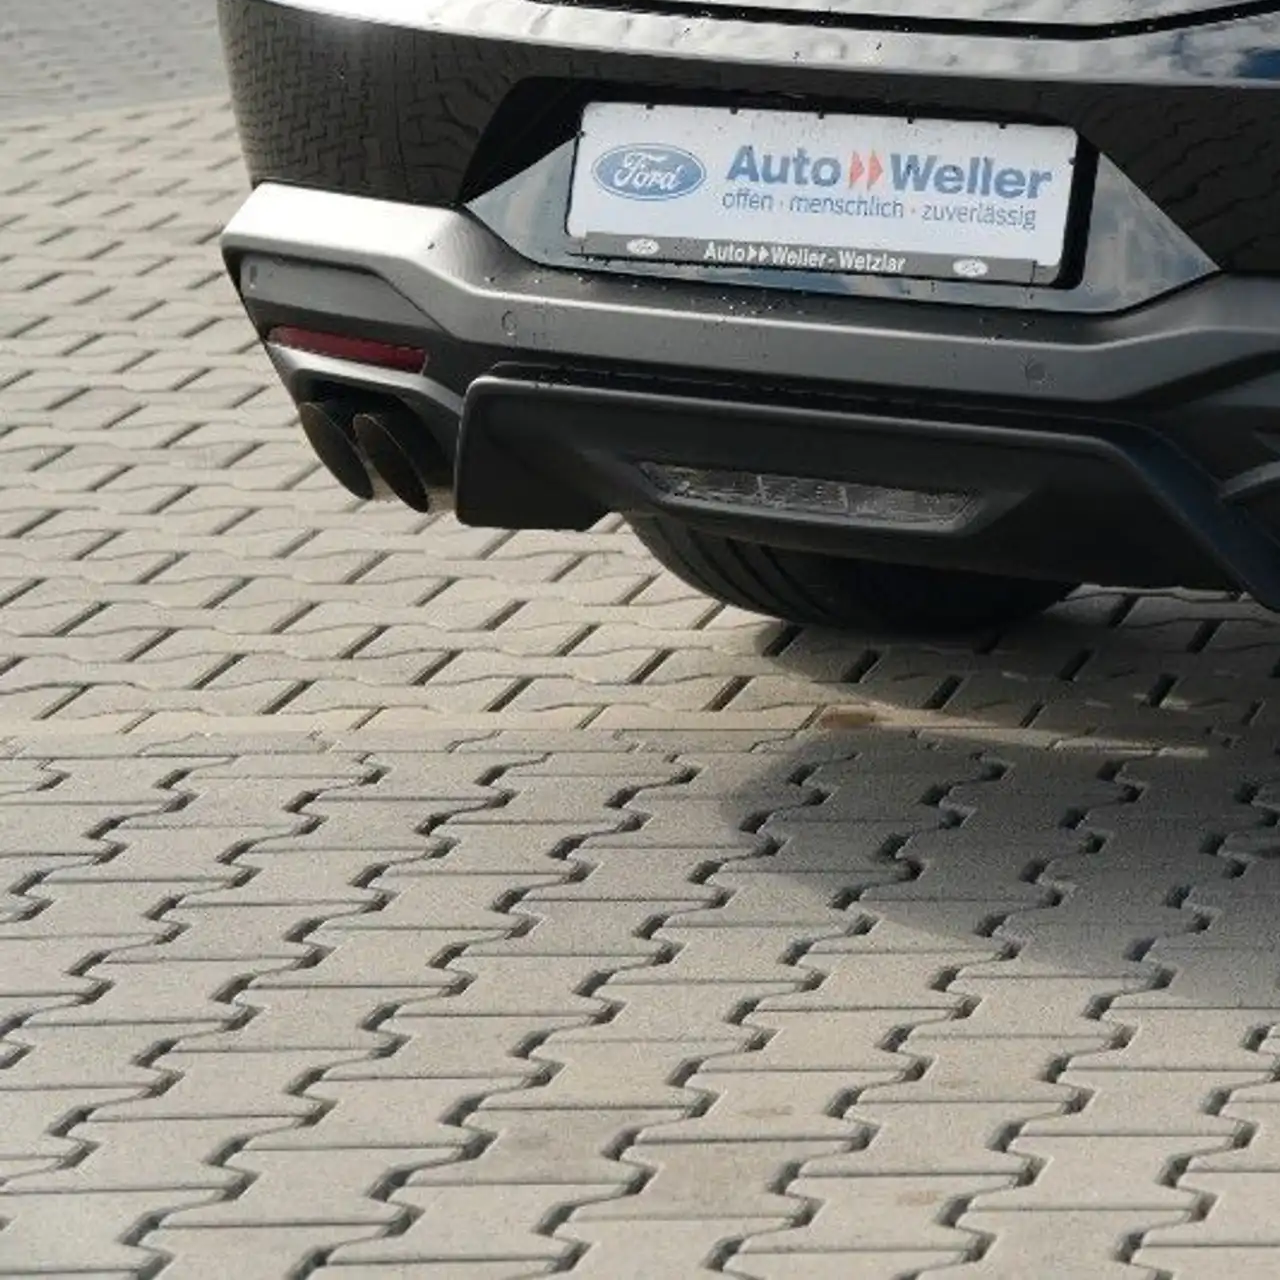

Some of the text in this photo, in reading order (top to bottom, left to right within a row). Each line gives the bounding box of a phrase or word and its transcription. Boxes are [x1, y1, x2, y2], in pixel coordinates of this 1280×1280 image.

[612, 149, 683, 192] Ford
[726, 144, 1053, 201] Auto Weller
[721, 189, 1037, 231] offen menschlich zuverlässig
[703, 239, 747, 263] Auto
